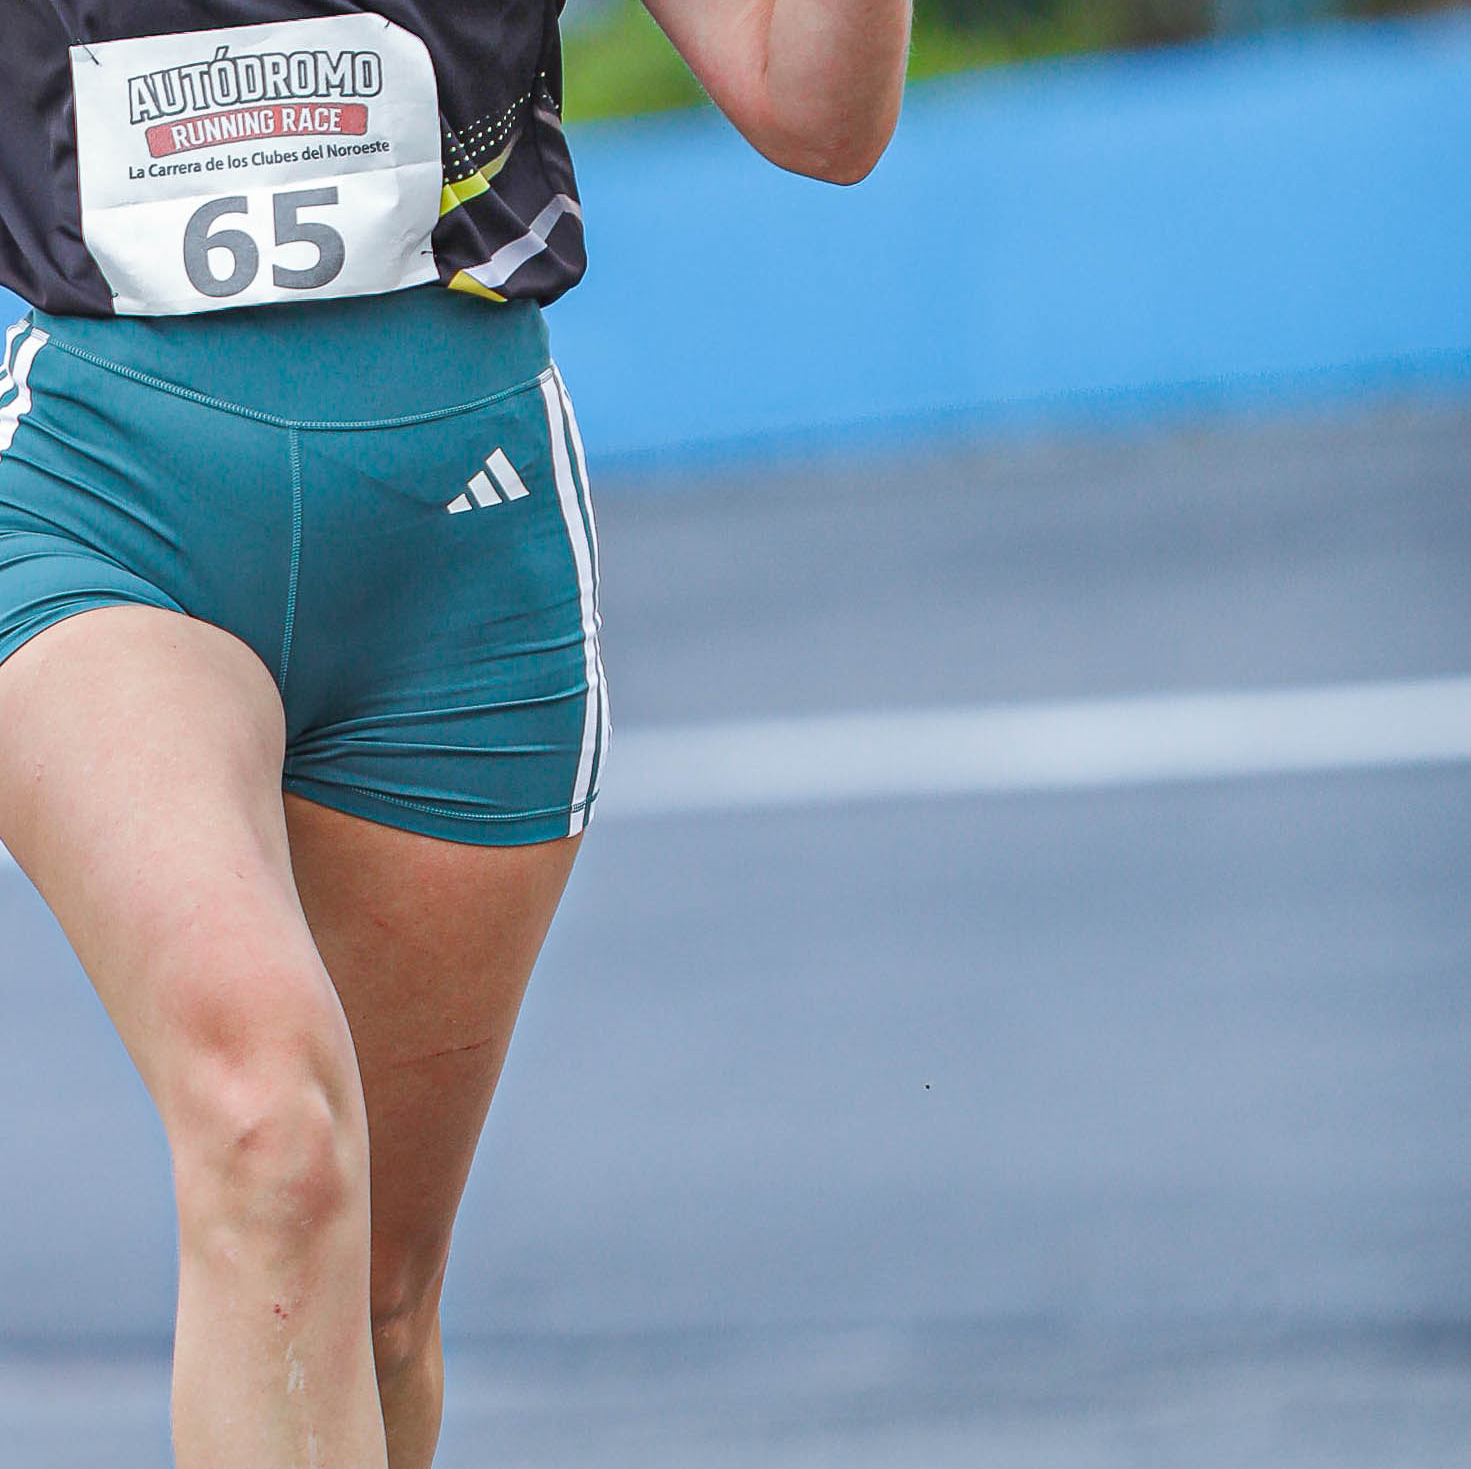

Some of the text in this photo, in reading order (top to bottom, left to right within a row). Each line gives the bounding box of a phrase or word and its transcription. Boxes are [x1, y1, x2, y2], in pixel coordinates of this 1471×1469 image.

[128, 46, 383, 124] AUTÓDROMO
[171, 108, 342, 149] RUNNING RACE
[129, 140, 390, 179] La Carrera de los Clubes del Noroeste
[183, 186, 346, 298] 65
